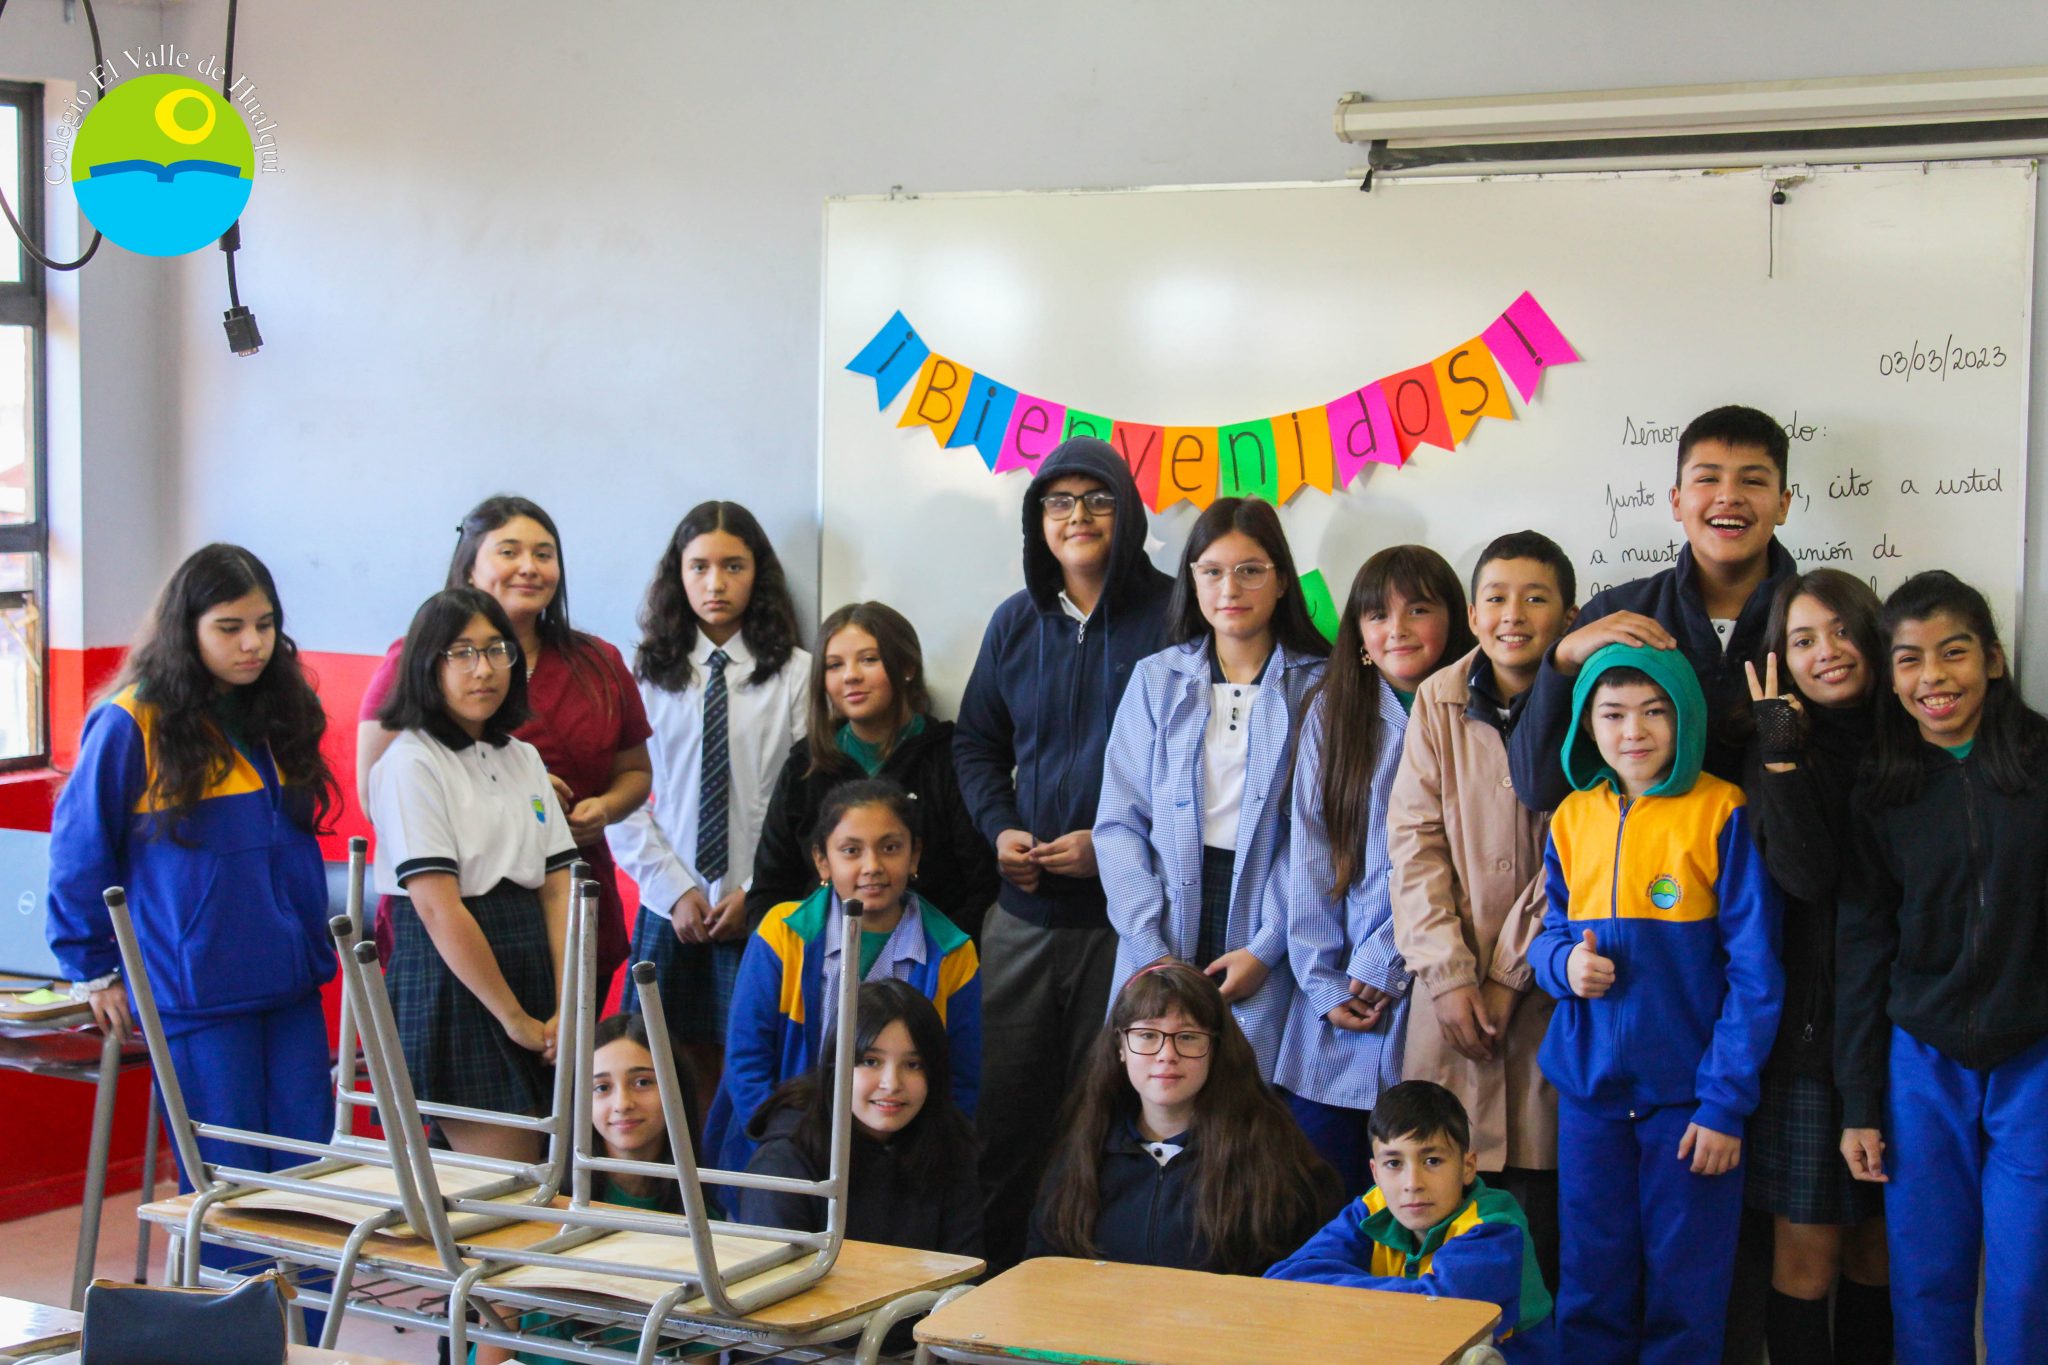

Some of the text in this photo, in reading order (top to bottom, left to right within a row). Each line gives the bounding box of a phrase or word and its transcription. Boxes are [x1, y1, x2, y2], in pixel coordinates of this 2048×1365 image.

[1879, 334, 2007, 382] 03/03/2023
[1828, 467, 1873, 499] cito
[1900, 478, 1919, 495] a
[1935, 468, 2003, 495] usted
[1590, 549, 1608, 565] a
[1872, 533, 1902, 560] de
